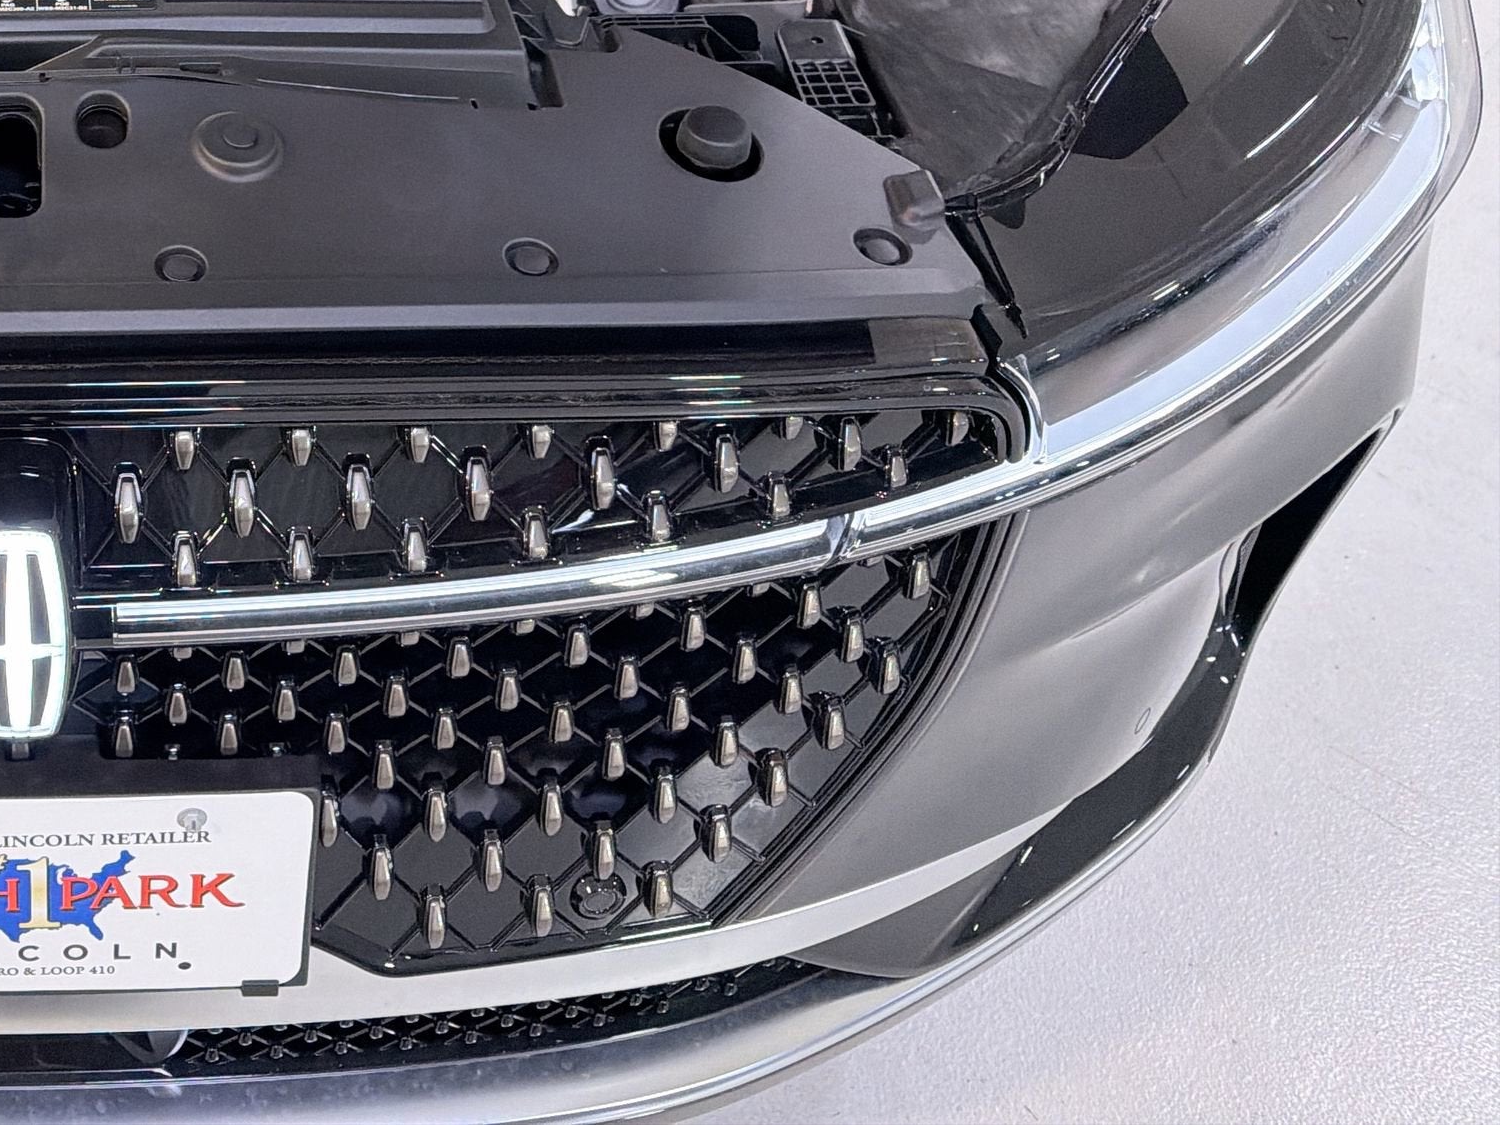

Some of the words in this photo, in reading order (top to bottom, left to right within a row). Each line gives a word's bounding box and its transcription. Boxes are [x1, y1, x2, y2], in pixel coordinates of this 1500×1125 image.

[100, 830, 212, 846] RETAILER
[60, 873, 246, 910] PARK
[23, 966, 37, 976] &
[41, 965, 85, 976] LOOP
[89, 965, 116, 975] 410
